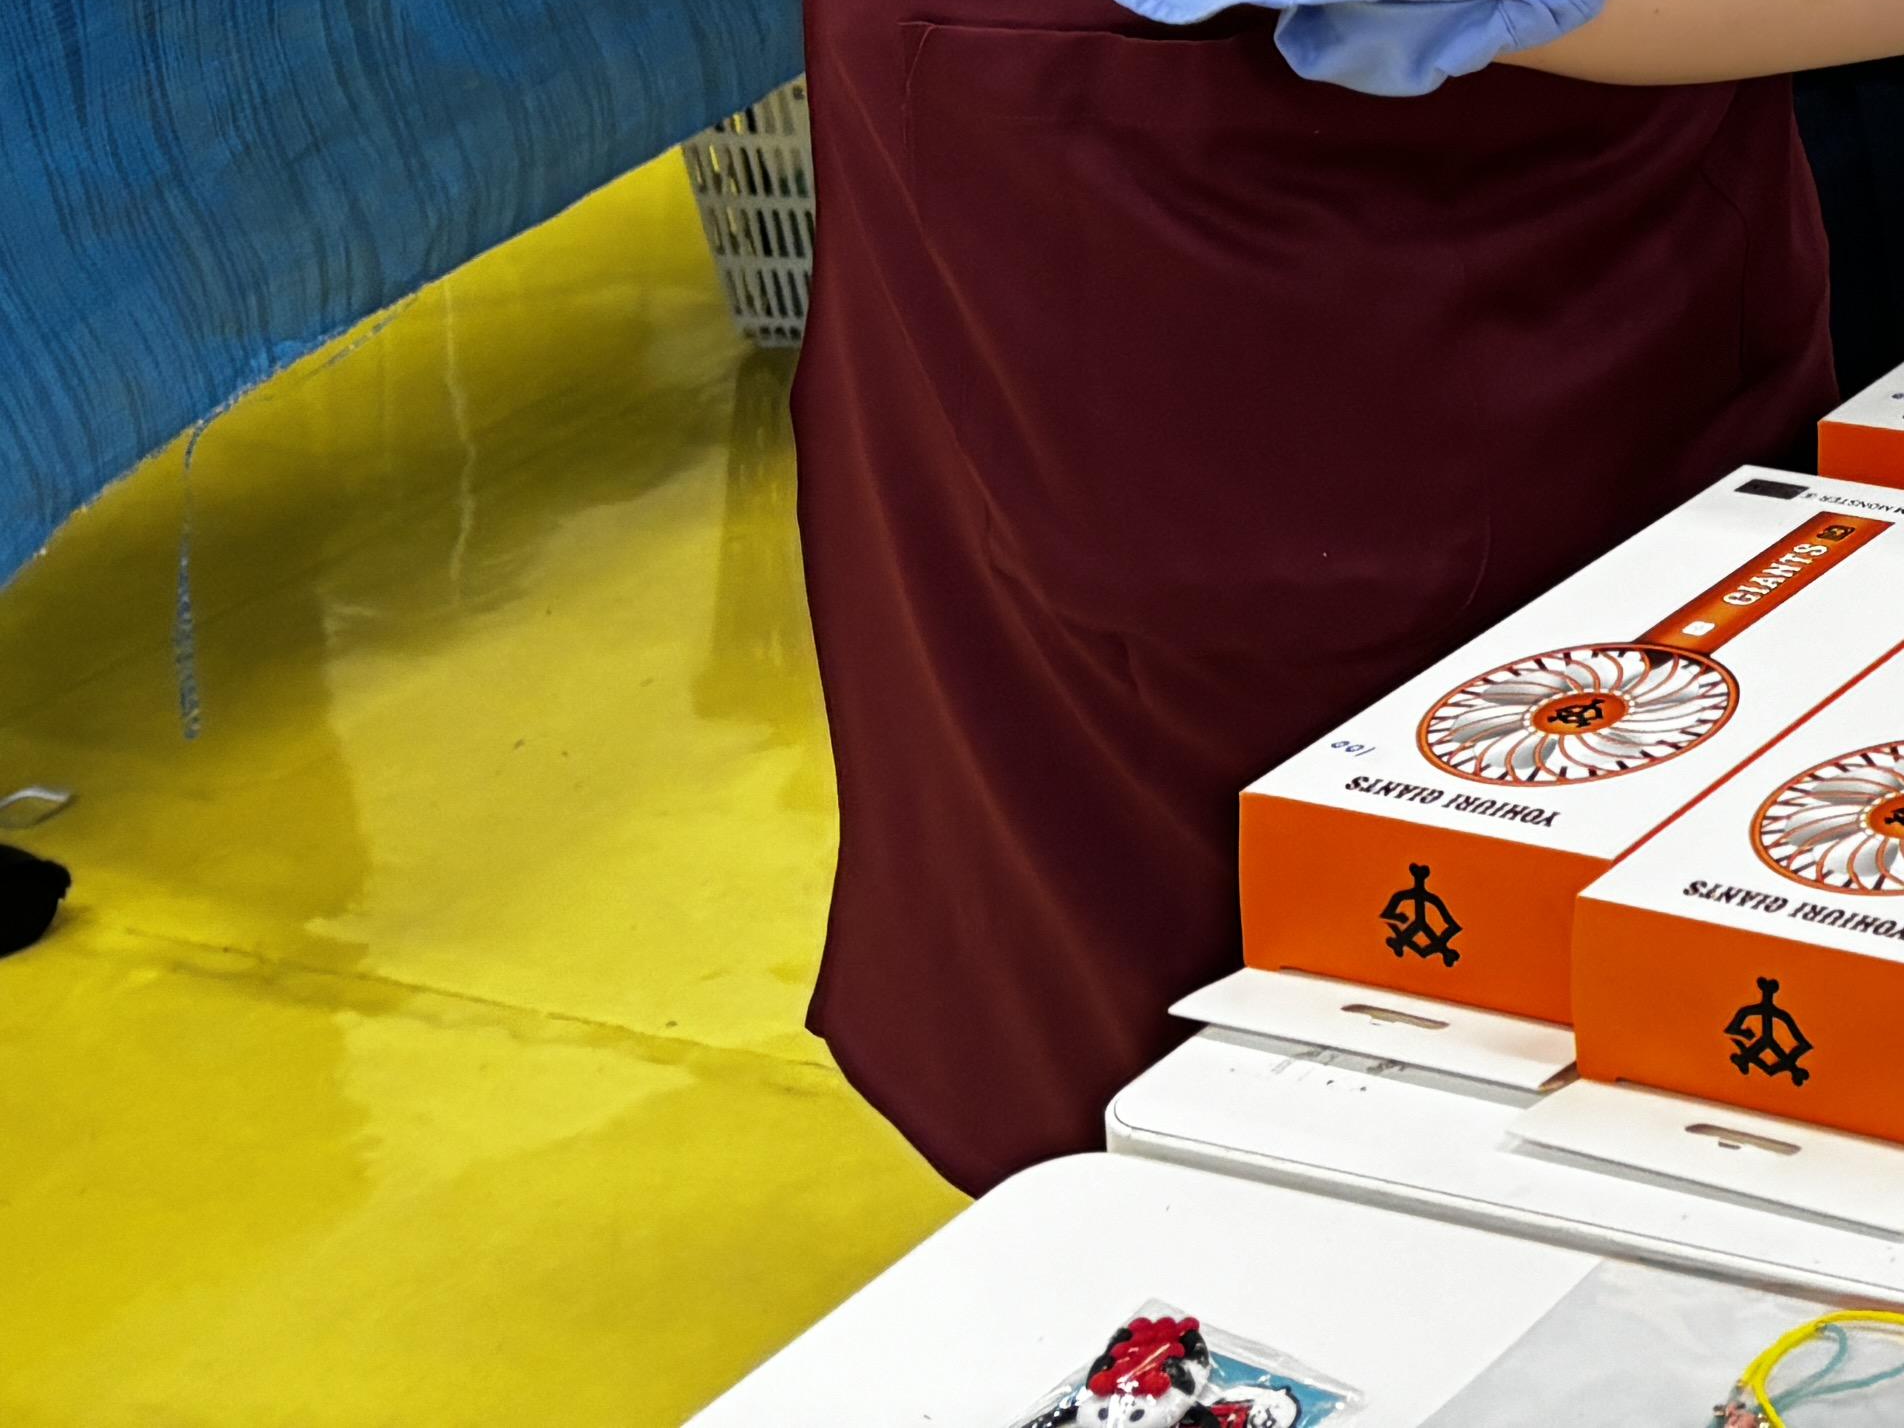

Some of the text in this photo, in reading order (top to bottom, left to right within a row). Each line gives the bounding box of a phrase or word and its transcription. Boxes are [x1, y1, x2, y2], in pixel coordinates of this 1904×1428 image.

[1722, 543, 1827, 606] GIANTS
[1345, 776, 1561, 829] YOMIURI GIANTS
[1683, 878, 1787, 915] GIANTS
